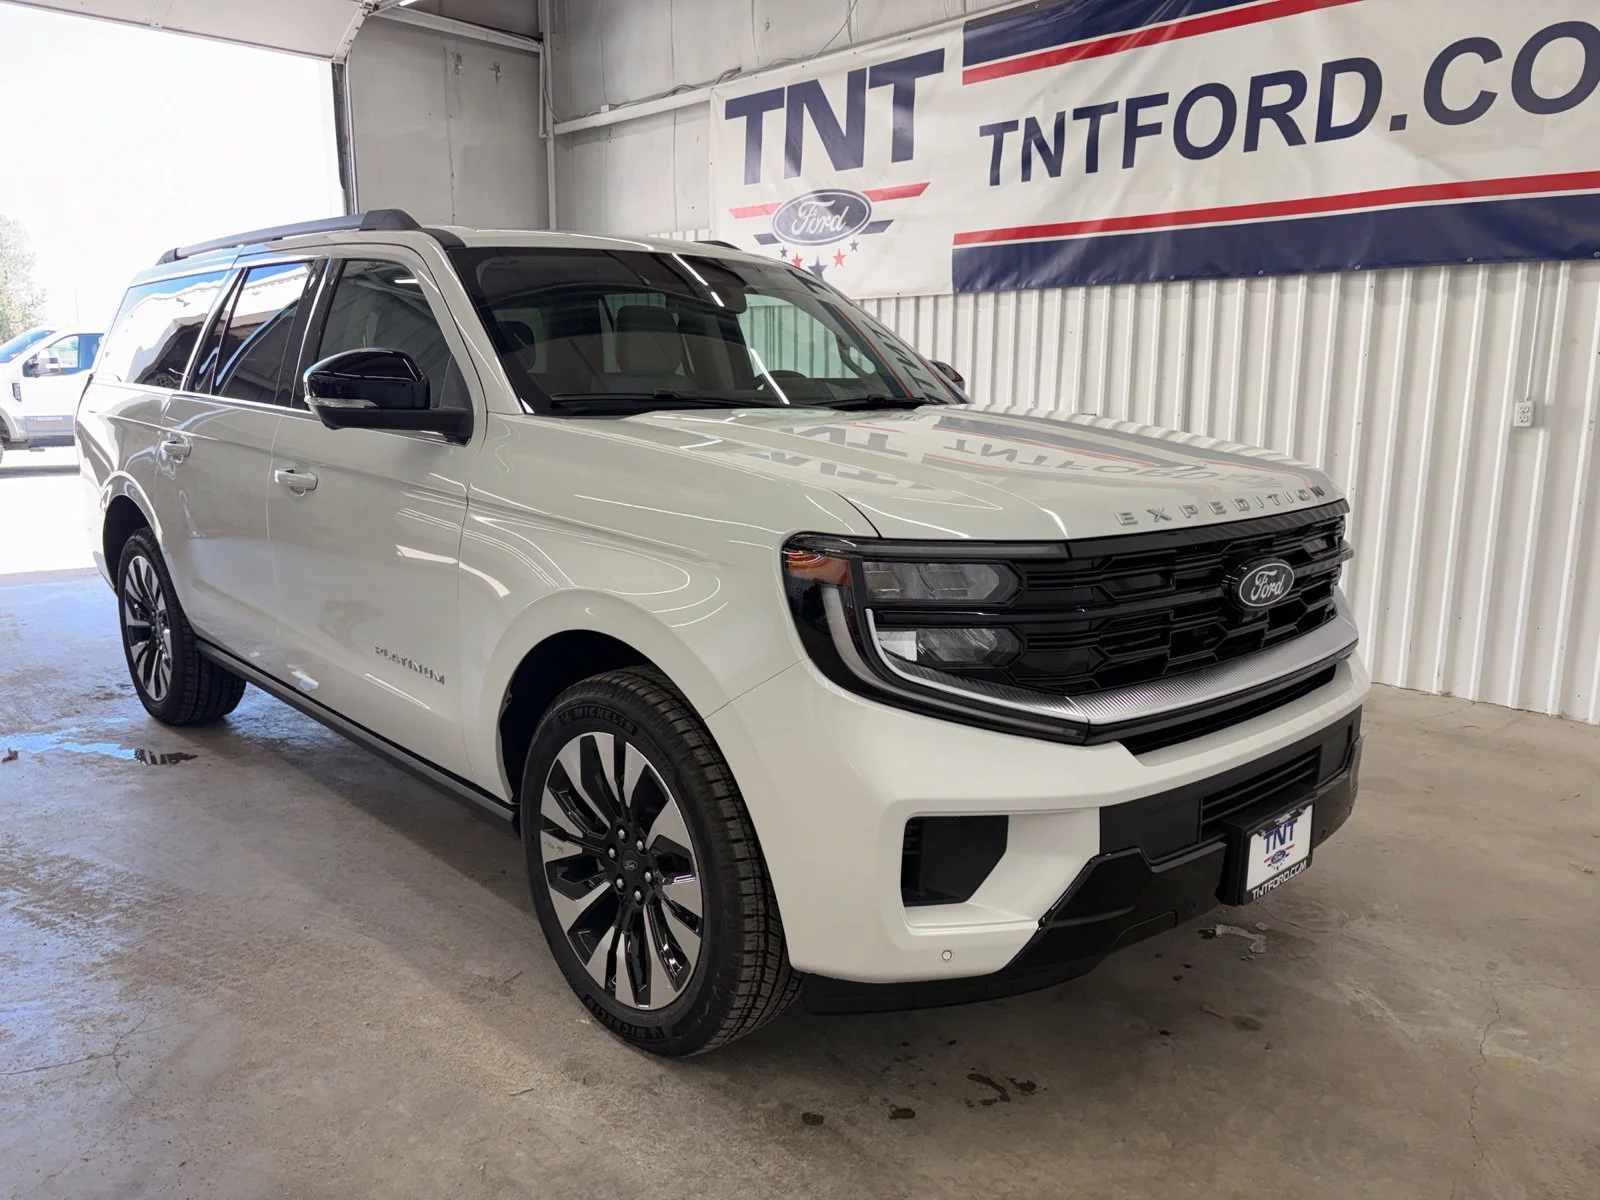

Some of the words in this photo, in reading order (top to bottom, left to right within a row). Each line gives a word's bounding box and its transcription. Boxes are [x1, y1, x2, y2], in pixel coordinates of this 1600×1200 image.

[725, 48, 945, 186] TNT
[791, 199, 850, 236] Ford
[1113, 486, 1326, 526] EXPEDITION
[1250, 570, 1287, 602] Ford
[375, 645, 445, 685] PLATINUM
[574, 706, 636, 733] MICHELIN
[1263, 817, 1298, 855] TNT
[1252, 859, 1307, 900] TNTFORD.COM
